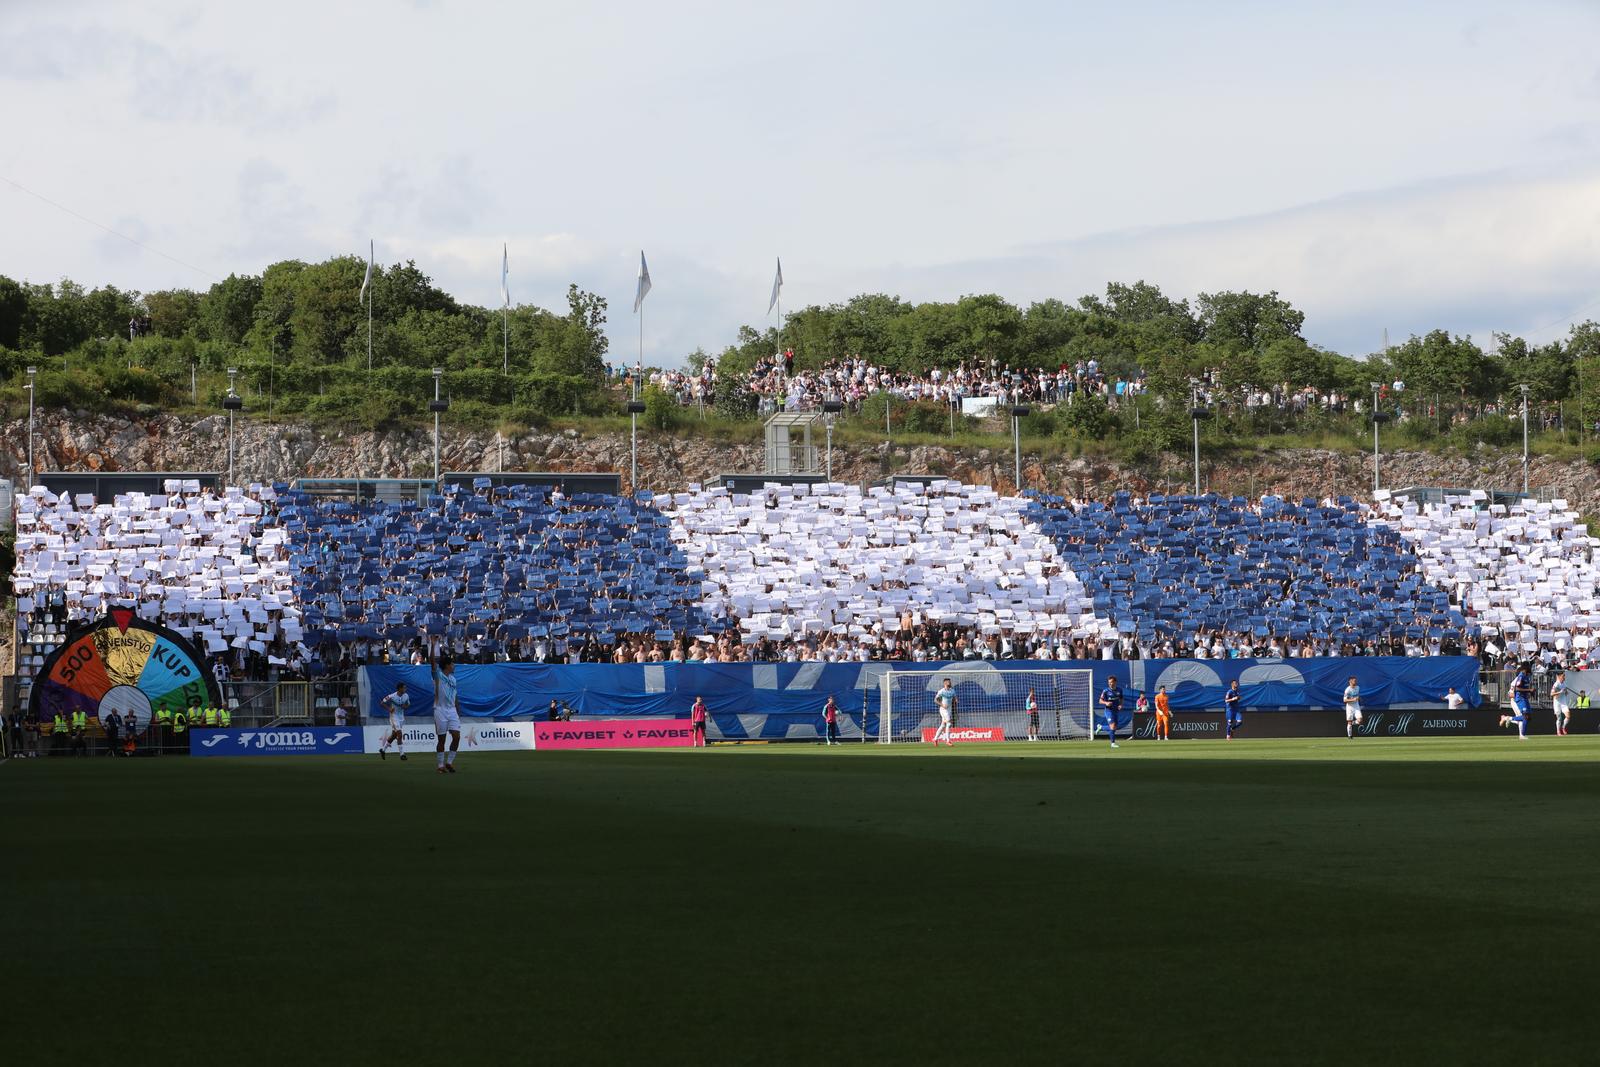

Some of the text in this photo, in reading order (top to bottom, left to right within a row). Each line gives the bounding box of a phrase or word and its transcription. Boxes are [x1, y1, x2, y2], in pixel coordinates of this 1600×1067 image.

[59, 644, 94, 683] 500
[152, 644, 192, 678] KUP
[1172, 722, 1209, 731] ZAJEDNO
[1423, 719, 1457, 729] ZAJEDNO
[403, 730, 435, 741] niline
[480, 727, 521, 739] uniline
[553, 730, 616, 741] FAVBET
